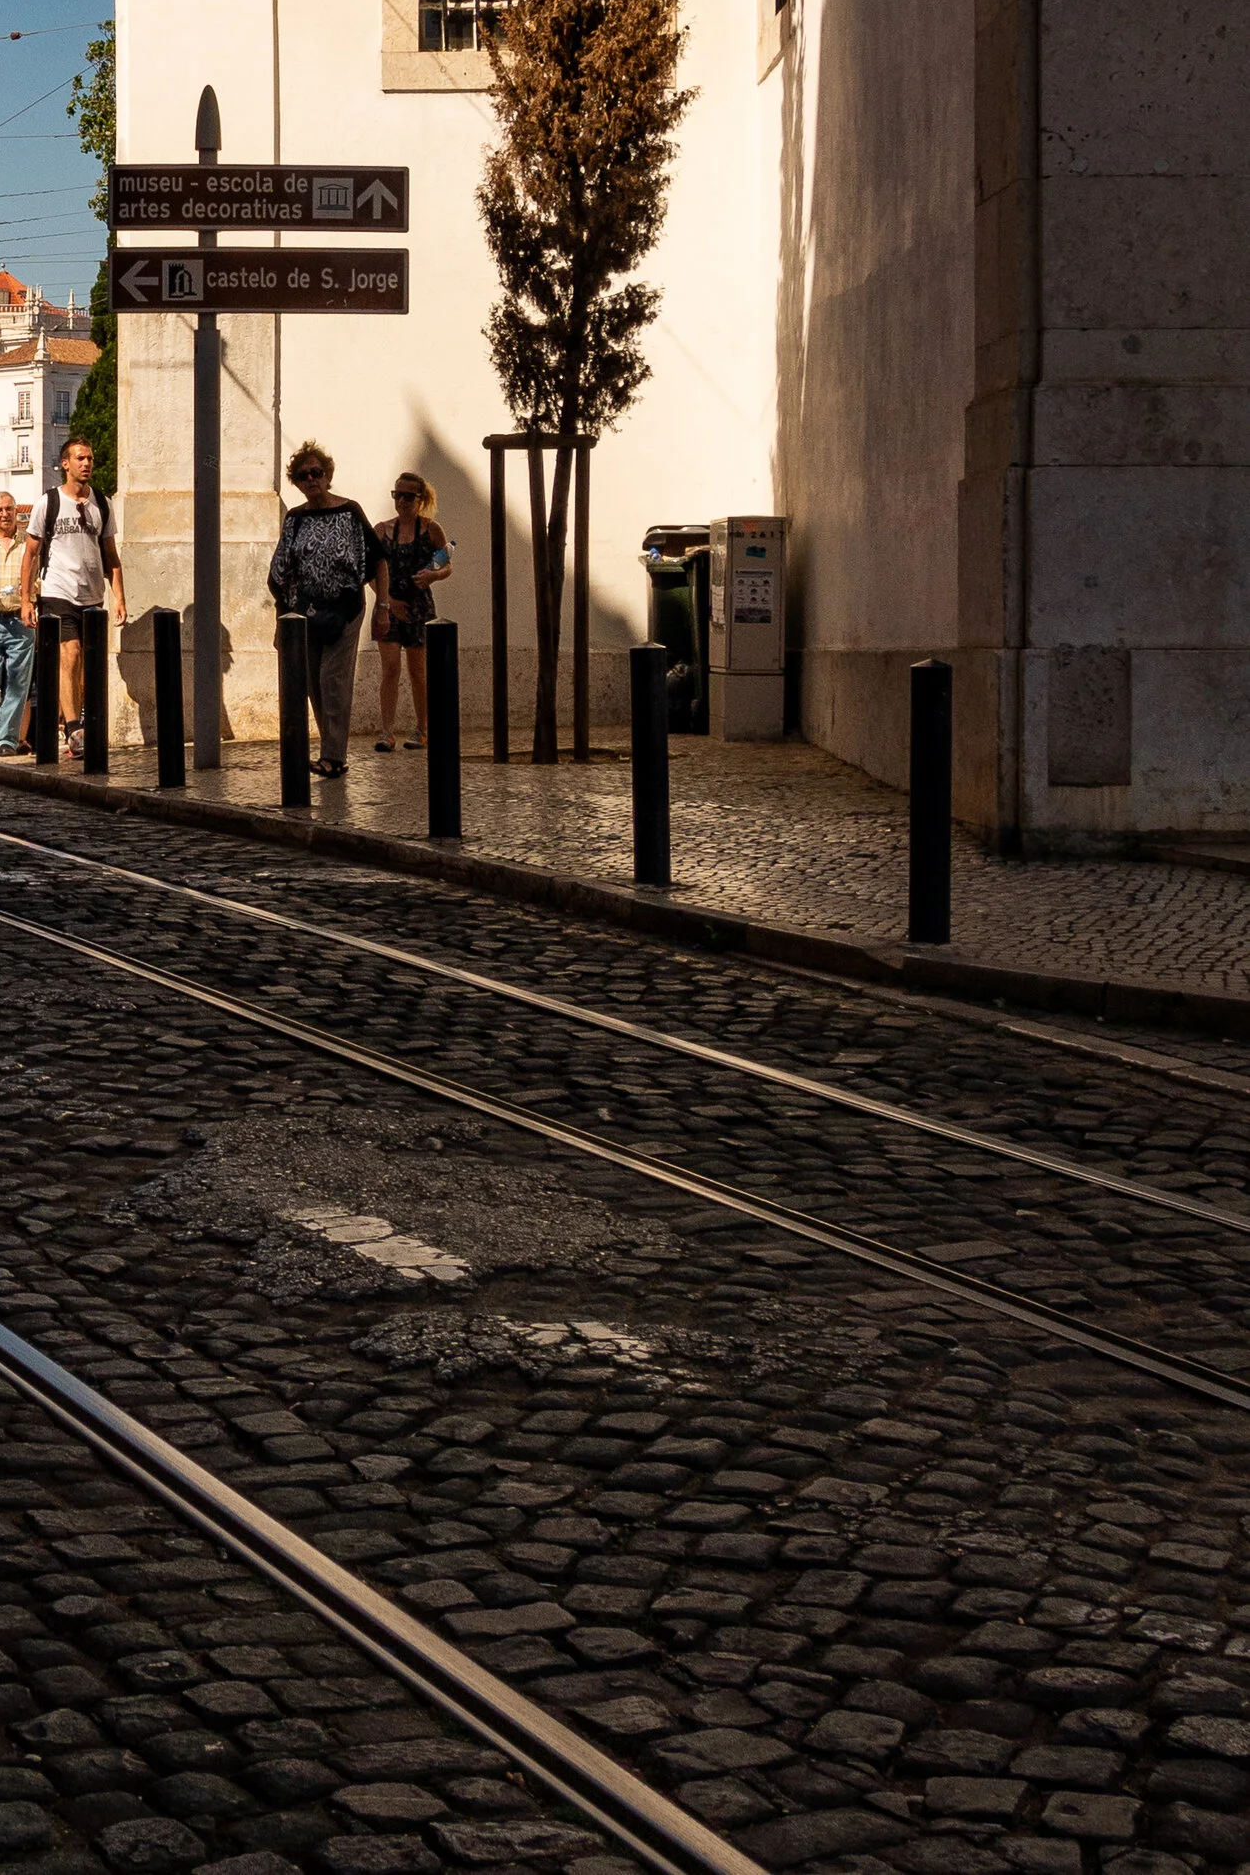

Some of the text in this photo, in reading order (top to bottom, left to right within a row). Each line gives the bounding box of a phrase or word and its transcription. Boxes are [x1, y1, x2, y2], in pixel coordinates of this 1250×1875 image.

[119, 176, 183, 192] museu
[206, 171, 273, 193] escola
[283, 173, 308, 193] de
[118, 198, 303, 219] artes decorativas
[206, 267, 399, 293] castelo de S. Jorge
